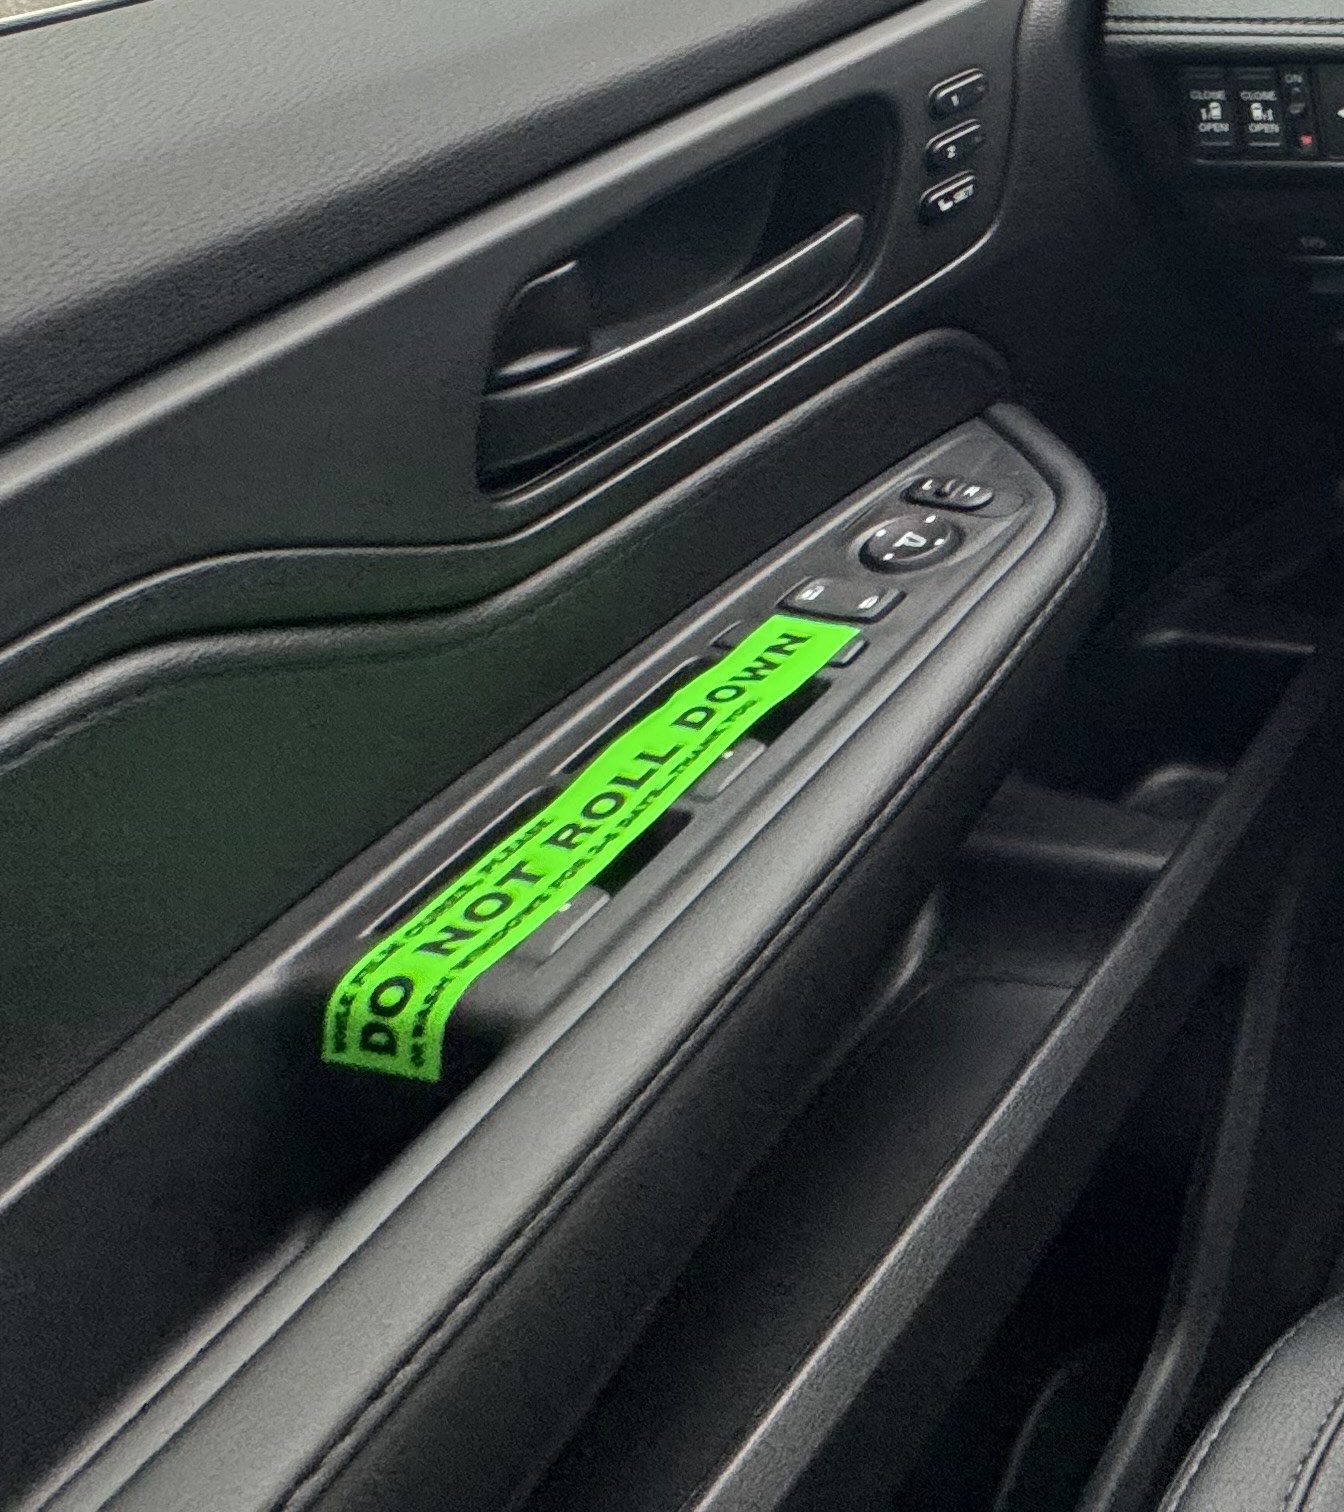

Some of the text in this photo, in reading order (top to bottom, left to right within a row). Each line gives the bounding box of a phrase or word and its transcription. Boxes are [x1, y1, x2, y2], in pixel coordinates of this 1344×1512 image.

[1240, 90, 1277, 101] CLOSE
[1199, 123, 1230, 133] OPEN
[1248, 123, 1280, 133] OPEN
[359, 630, 814, 1057] DO NOT ROLL DOWN
[547, 856, 594, 890] FOR
